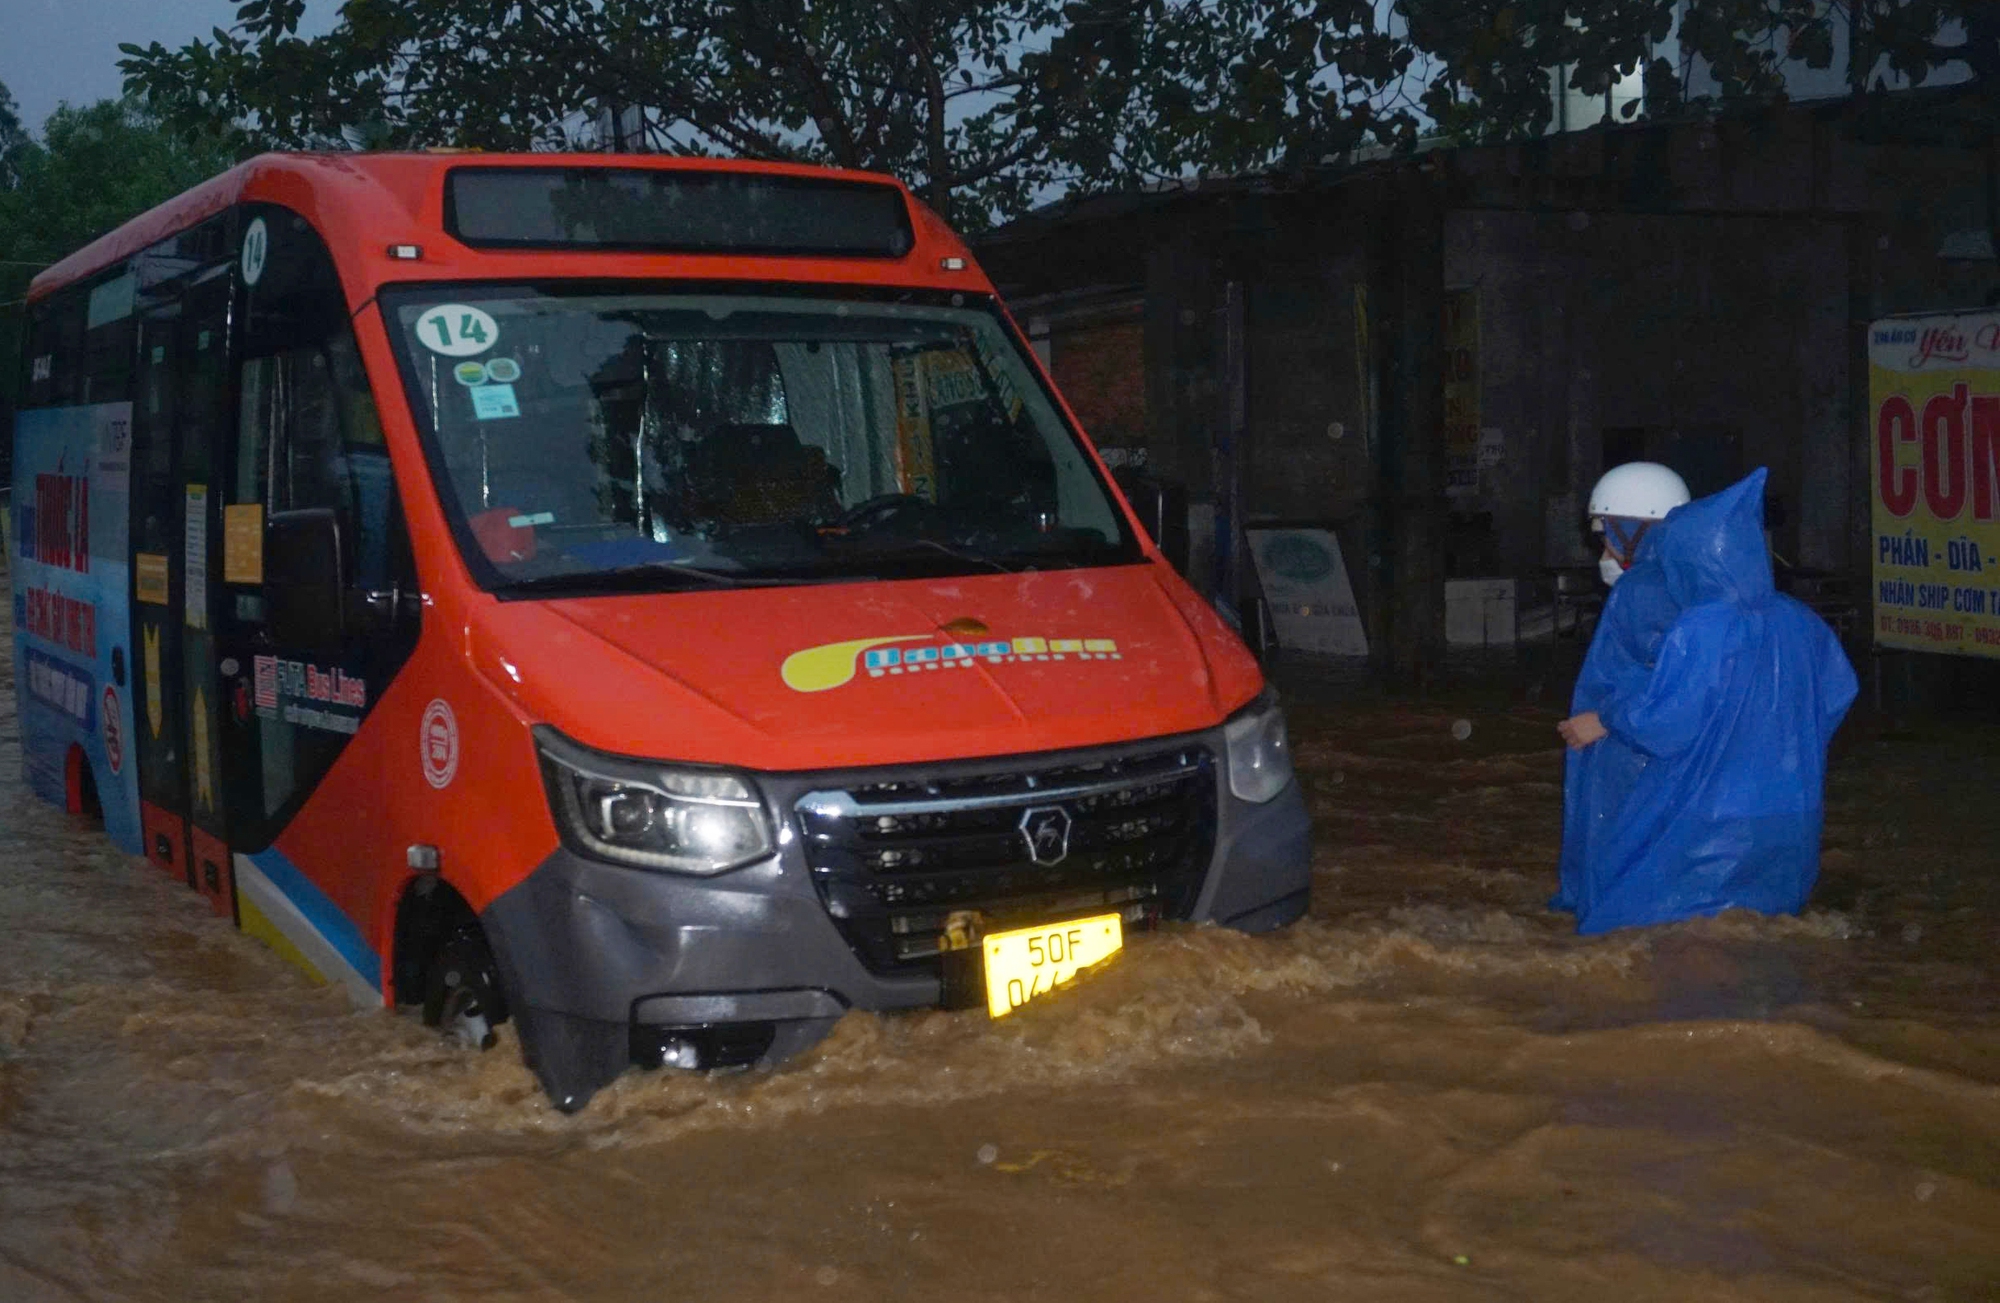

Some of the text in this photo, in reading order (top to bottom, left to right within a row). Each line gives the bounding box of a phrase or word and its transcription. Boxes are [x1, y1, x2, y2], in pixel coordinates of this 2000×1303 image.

[247, 235, 263, 273] 14
[428, 314, 488, 346] 14
[1918, 583, 1948, 611] SHIP
[1028, 930, 1081, 967] 50F
